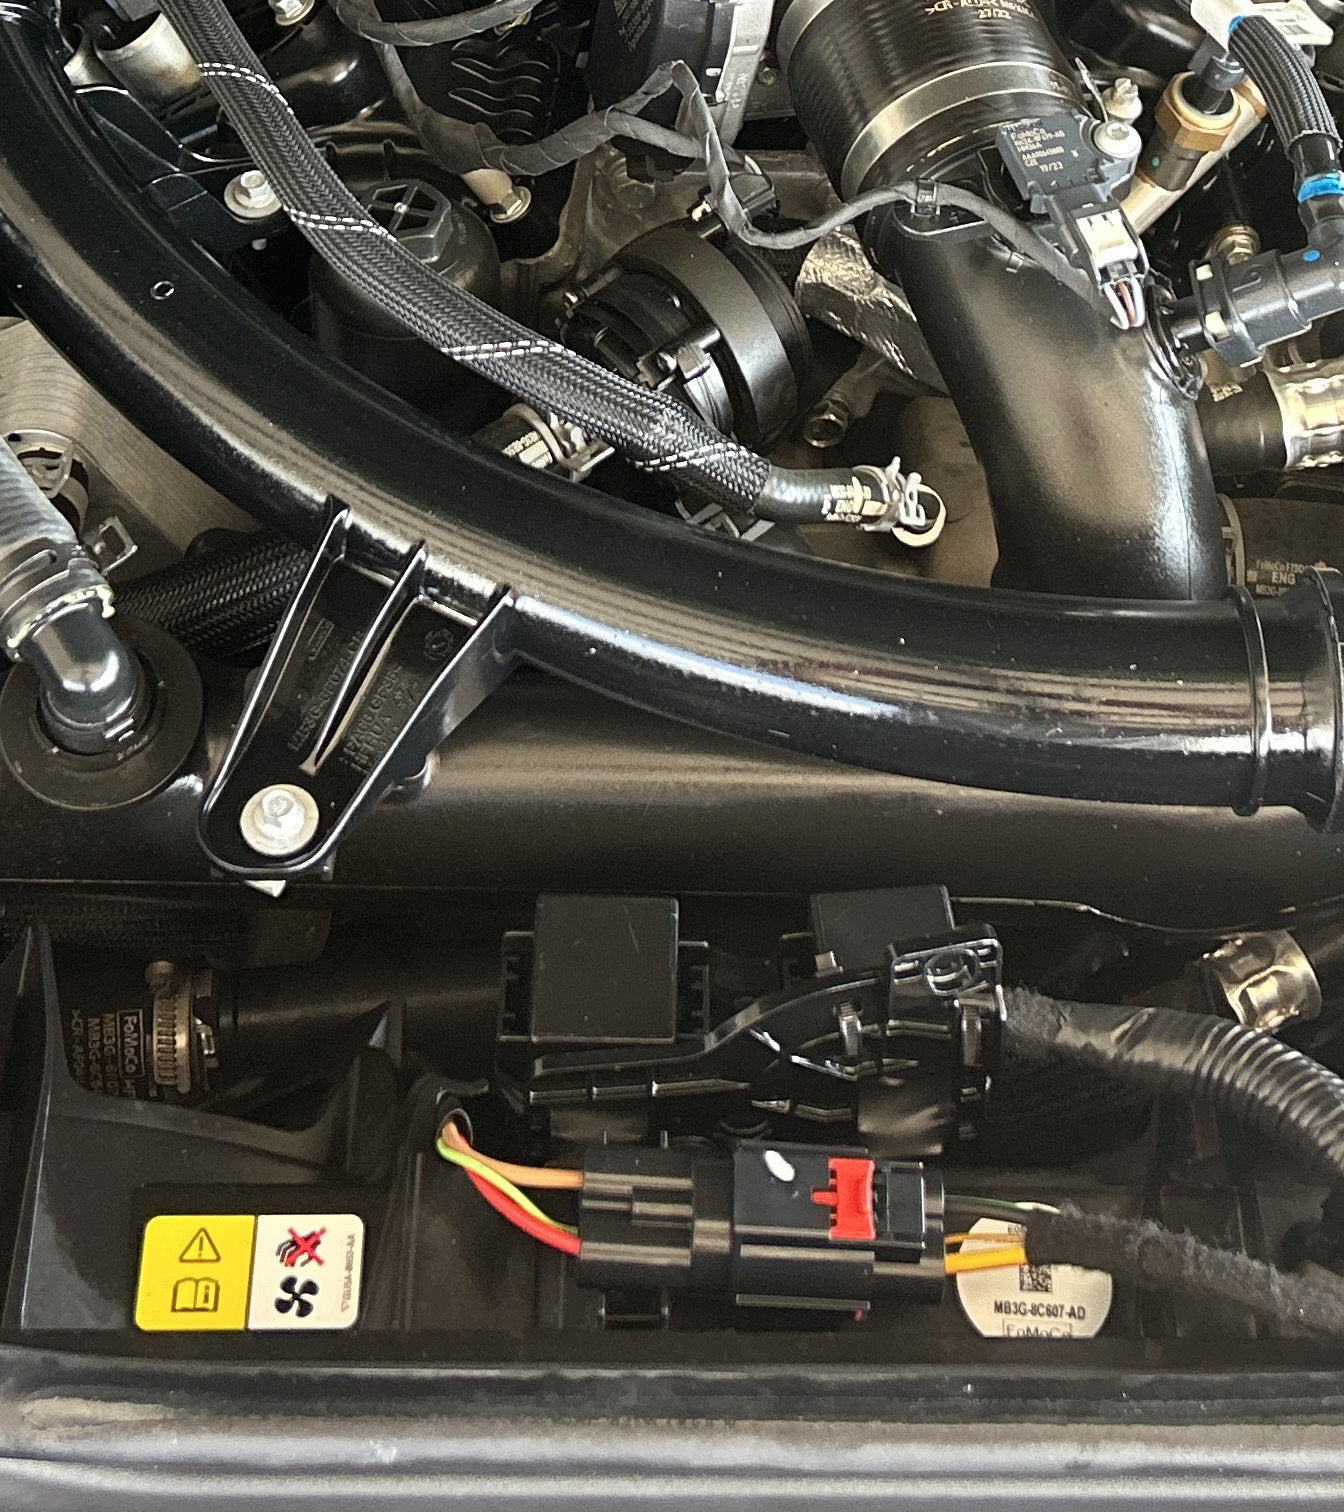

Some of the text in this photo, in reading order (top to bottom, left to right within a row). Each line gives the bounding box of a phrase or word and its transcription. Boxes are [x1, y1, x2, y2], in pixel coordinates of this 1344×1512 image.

[1271, 571, 1297, 585] ENG
[122, 1014, 139, 1075] FoMoCo
[992, 1299, 1087, 1322] MB3G-8C607-AD
